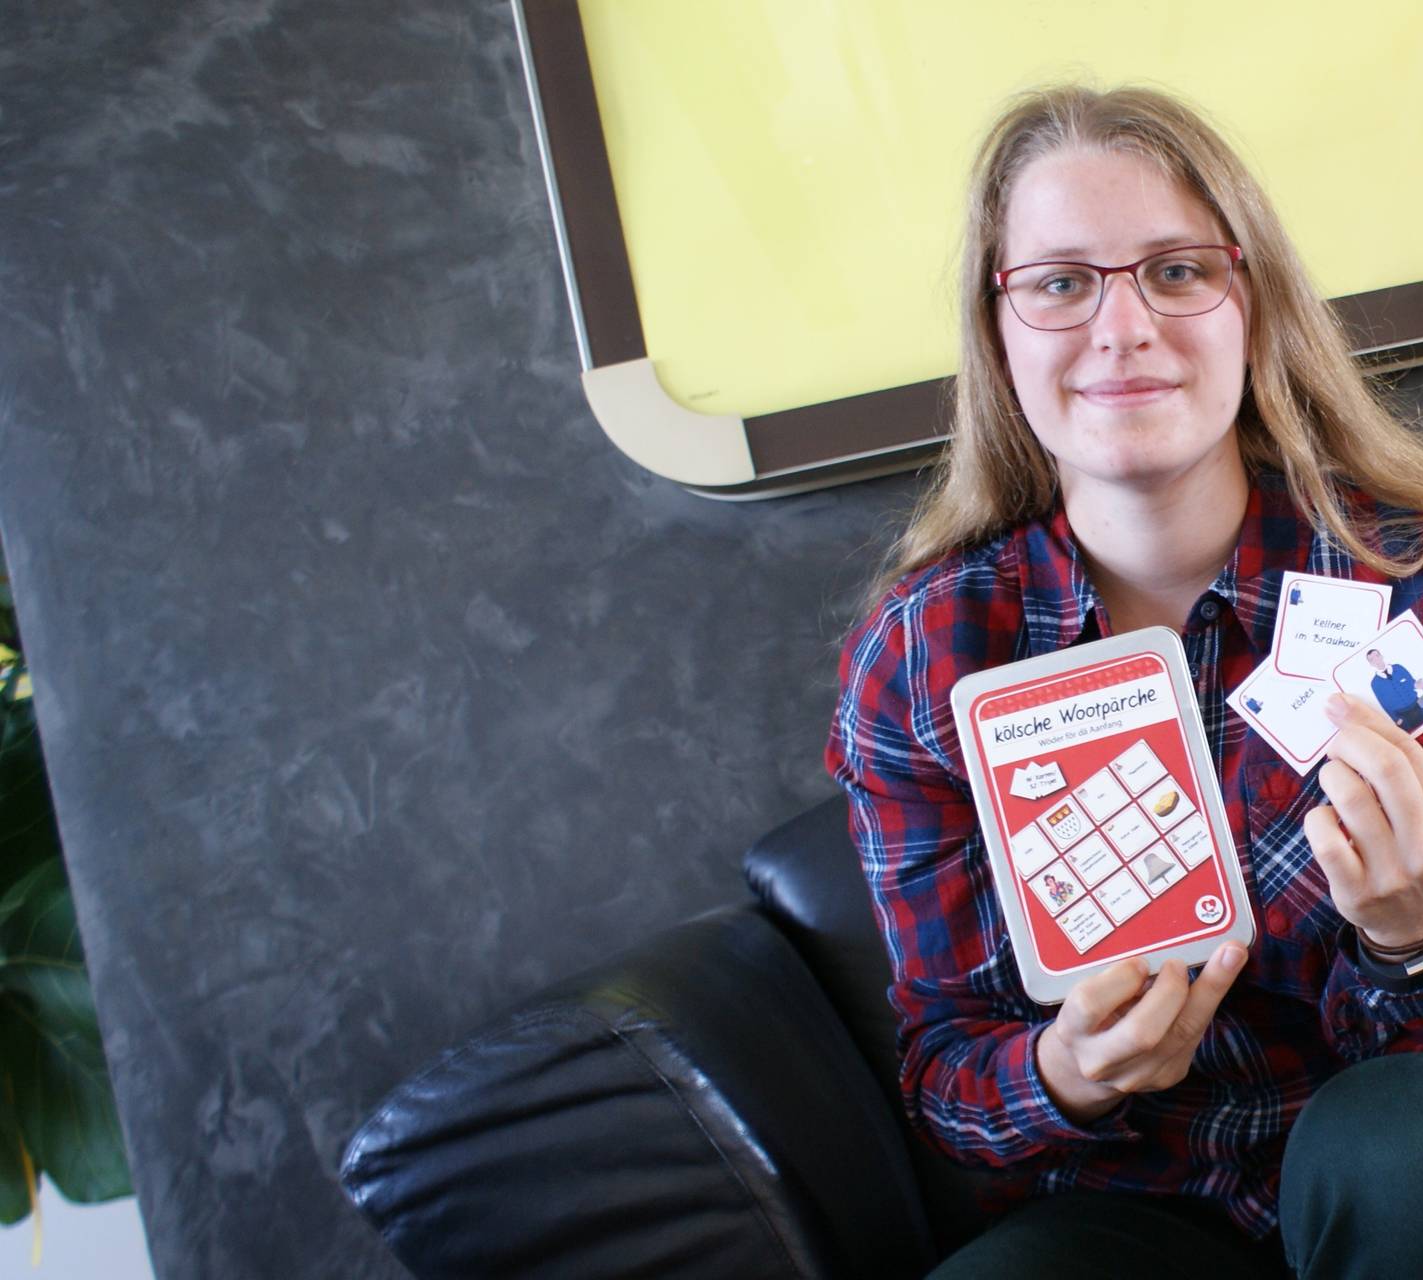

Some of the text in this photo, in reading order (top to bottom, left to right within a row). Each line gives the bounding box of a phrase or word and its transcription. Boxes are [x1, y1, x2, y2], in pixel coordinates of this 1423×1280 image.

[1313, 618, 1347, 631] Kellner
[1295, 632, 1360, 648] im Brauhau
[994, 688, 1158, 744] kölsche Wootpärche
